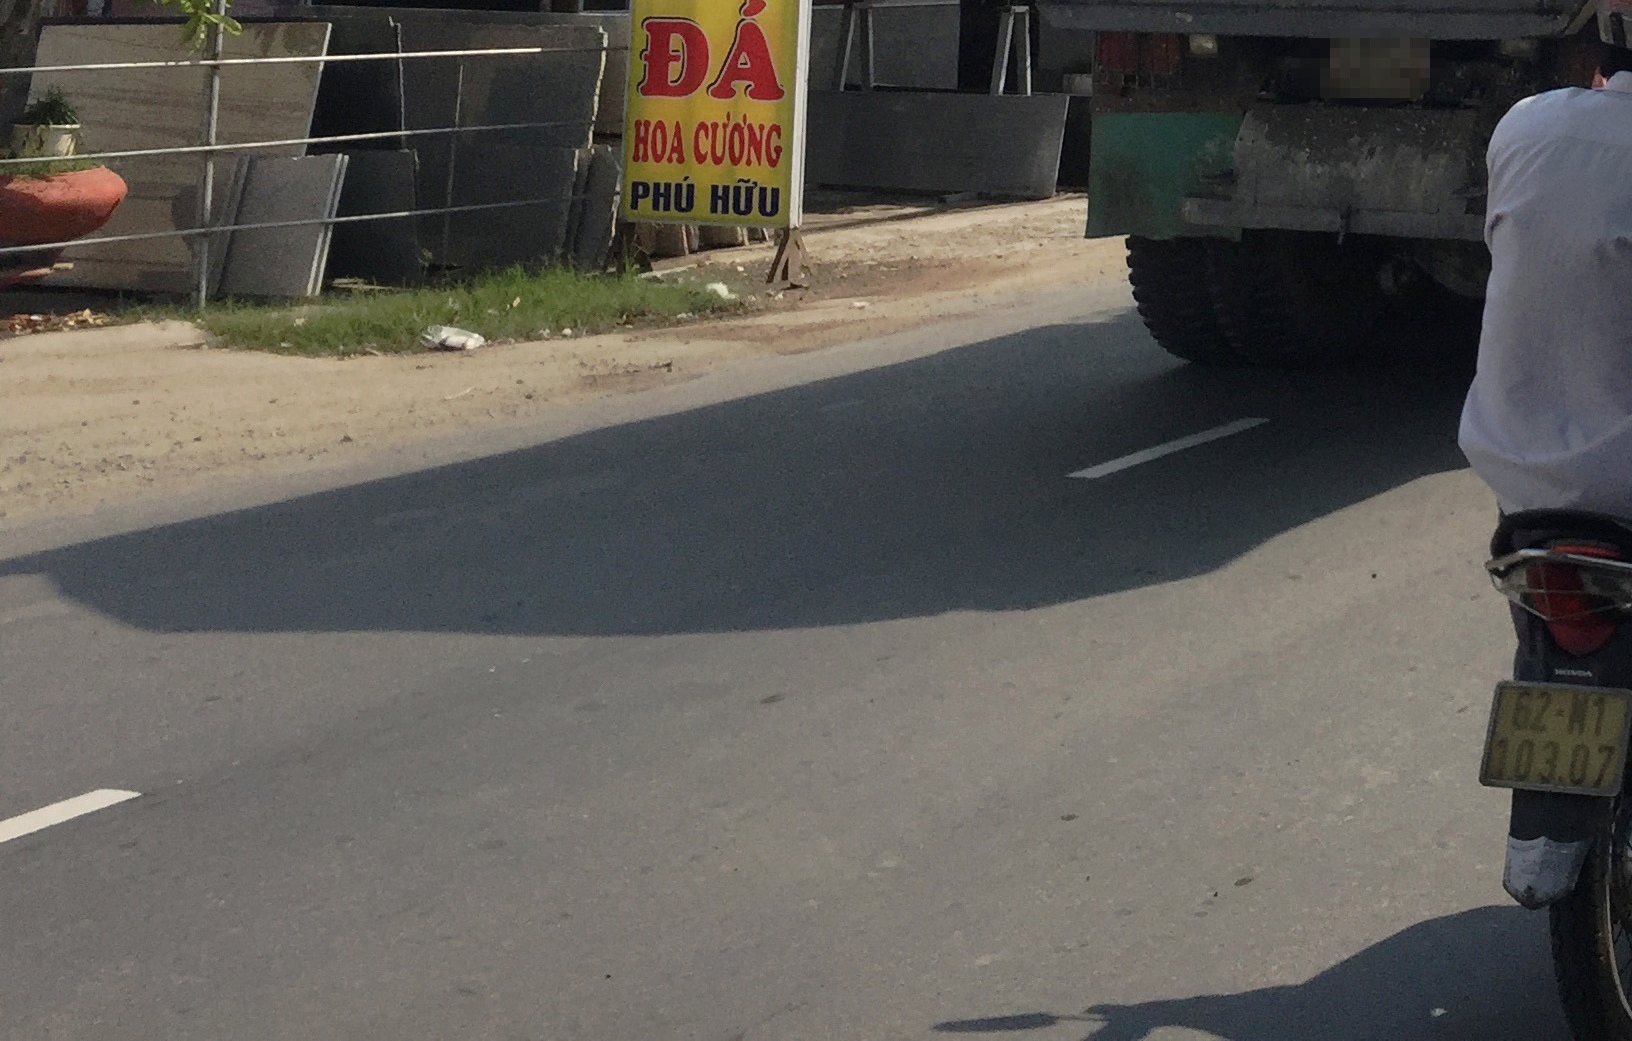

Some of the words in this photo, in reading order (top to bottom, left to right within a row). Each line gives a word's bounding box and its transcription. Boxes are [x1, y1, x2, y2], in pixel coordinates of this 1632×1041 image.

[633, 118, 686, 166] HOA
[693, 112, 783, 169] CƯƠNG
[630, 176, 695, 213] PHÚ
[709, 178, 781, 218] HỮU
